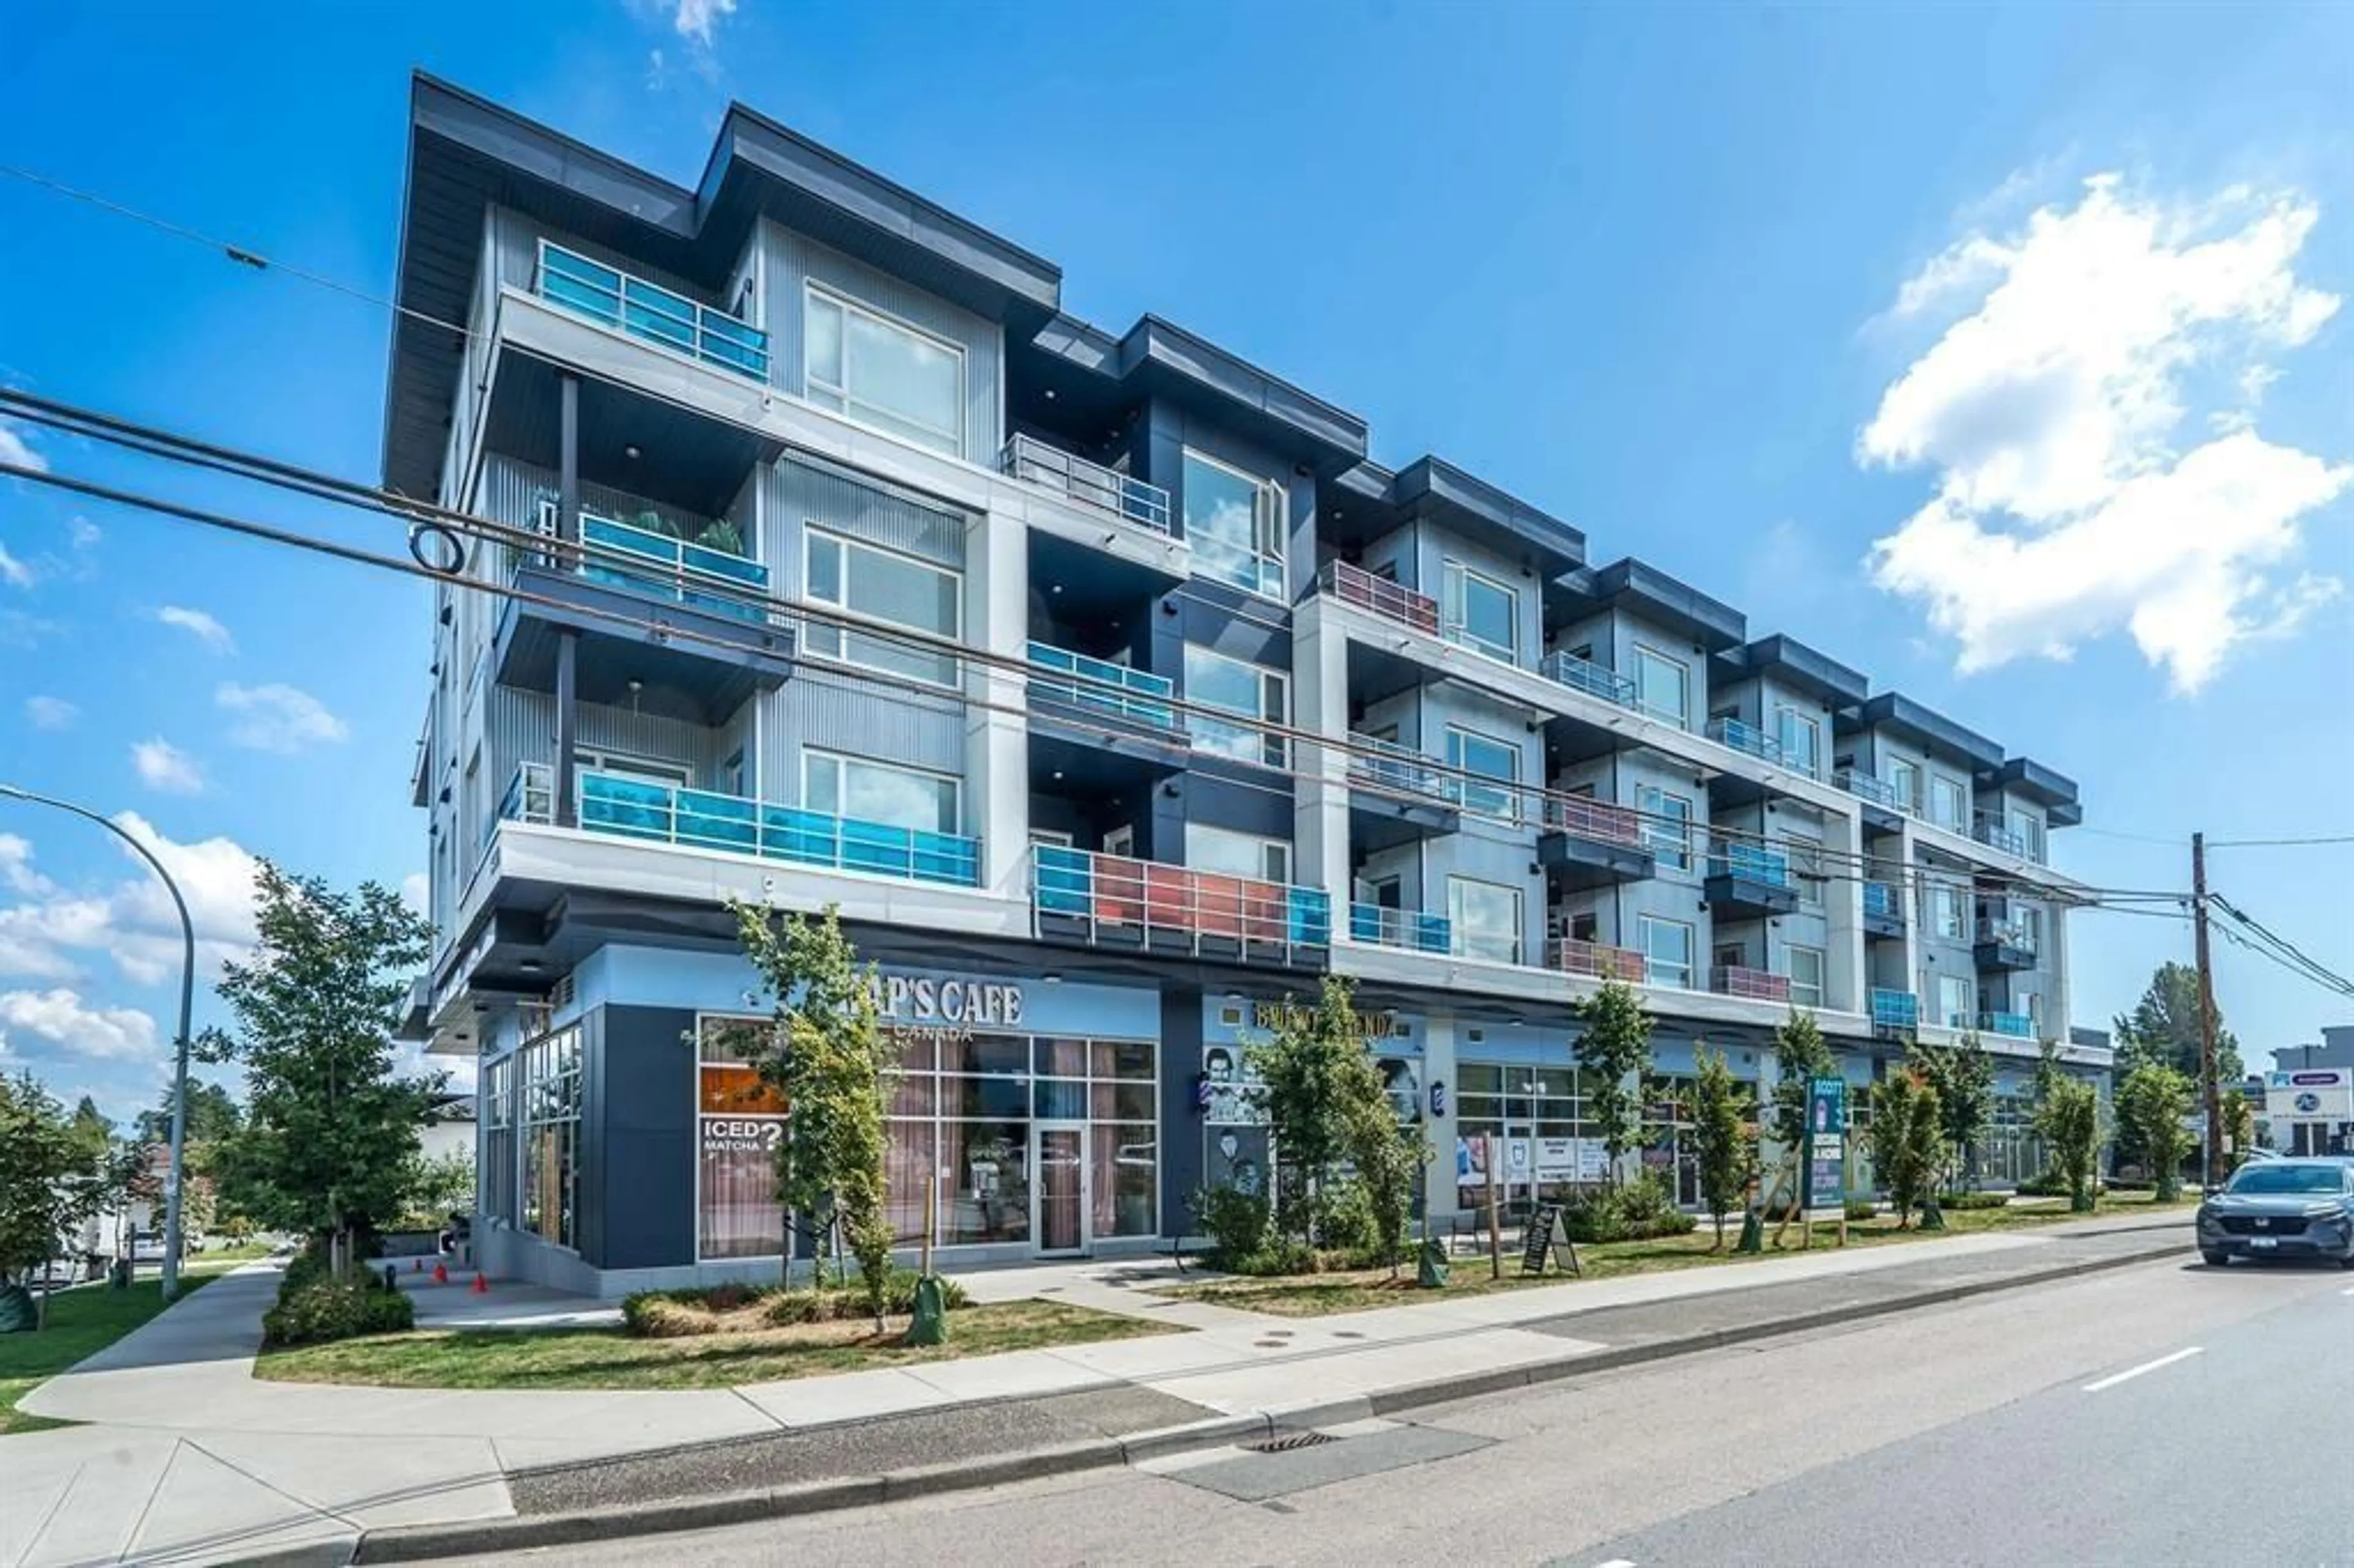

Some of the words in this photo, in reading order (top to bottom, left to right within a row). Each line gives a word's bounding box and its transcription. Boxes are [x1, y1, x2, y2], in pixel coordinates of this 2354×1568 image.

[940, 981, 1023, 1025] CAFE
[894, 1022, 973, 1042] CANADA
[705, 1121, 760, 1137] ICED
[704, 1140, 760, 1151] MATCHA
